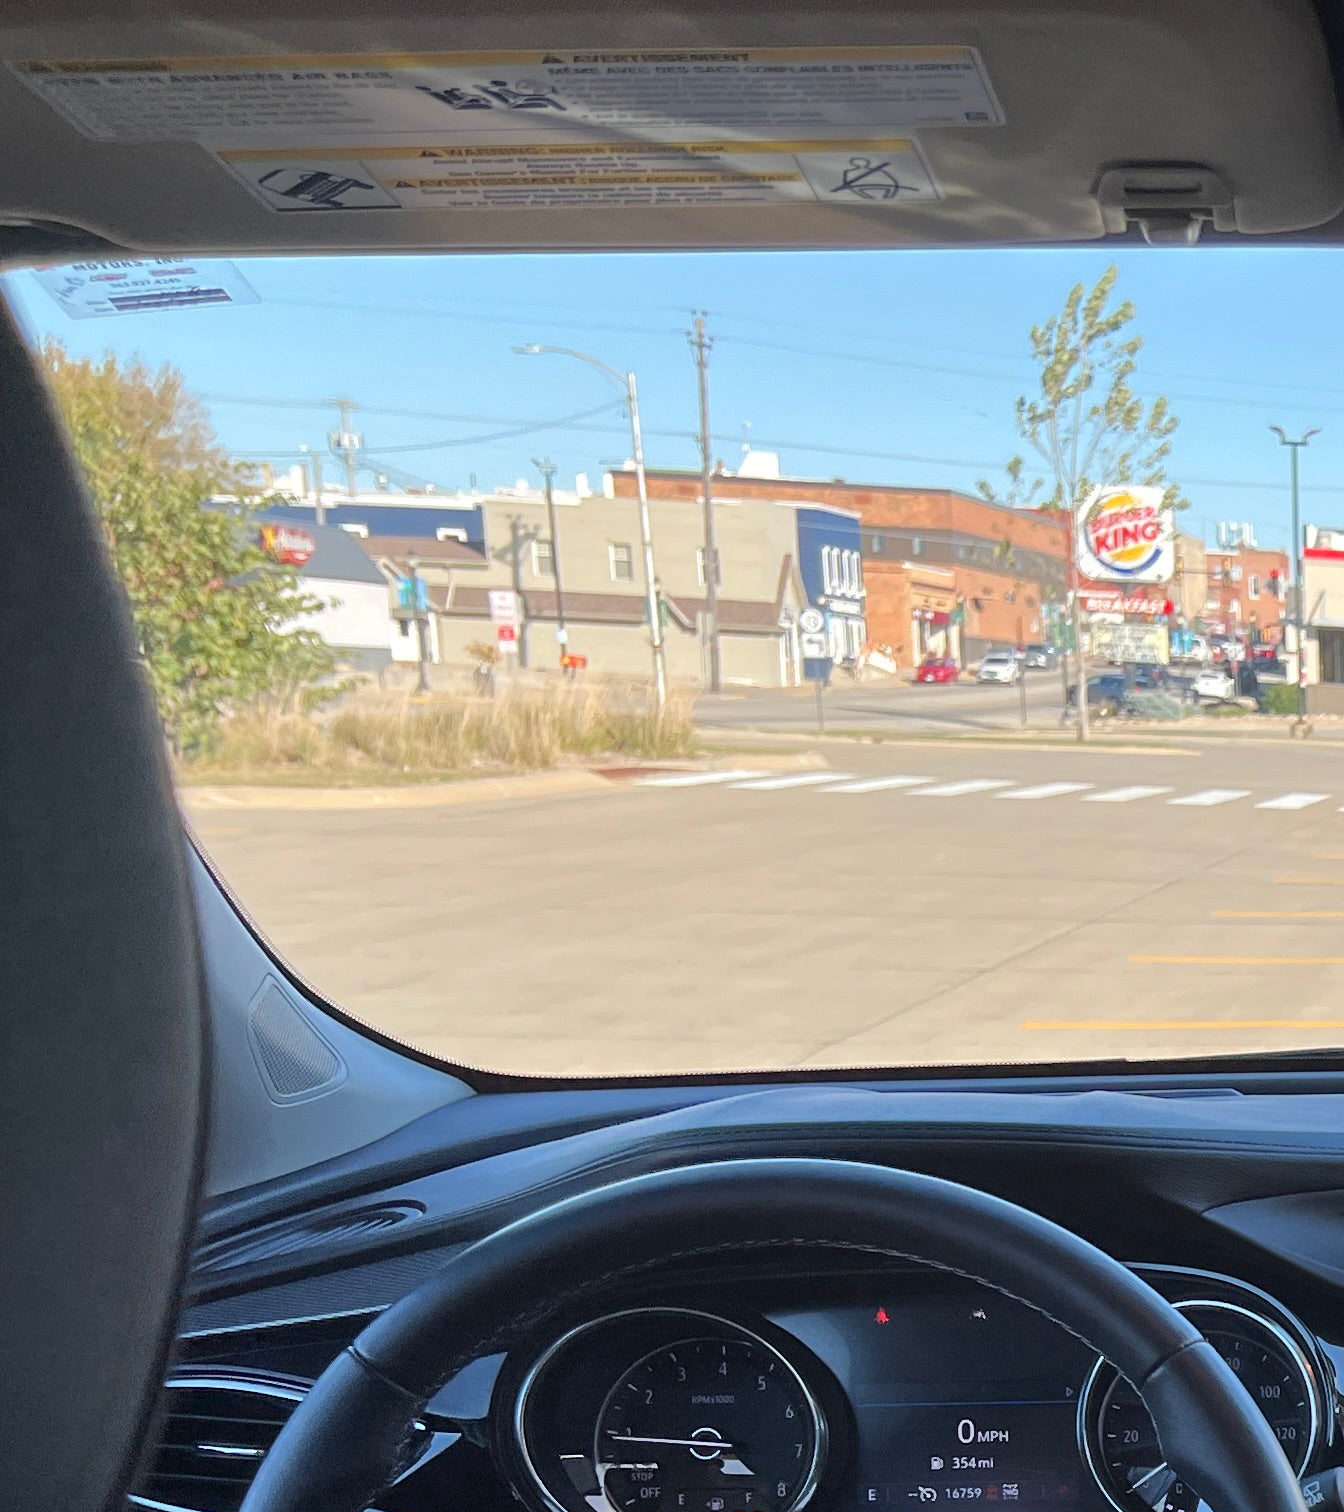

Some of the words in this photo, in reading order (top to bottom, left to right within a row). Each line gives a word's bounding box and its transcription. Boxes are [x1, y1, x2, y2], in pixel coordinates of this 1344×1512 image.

[1094, 521, 1162, 557] KING
[677, 1367, 686, 1382] 3
[719, 1361, 728, 1376] 4
[757, 1375, 767, 1391] 5
[645, 1389, 653, 1405] 2
[1259, 1384, 1281, 1399] 100
[785, 1405, 795, 1419] 6
[957, 1418, 975, 1444] 0
[977, 1430, 1009, 1443] MPH
[1123, 1430, 1139, 1444] 20
[1275, 1426, 1296, 1440] 120
[794, 1443, 803, 1458] 7
[952, 1457, 976, 1469] 354
[978, 1457, 994, 1469] mi
[640, 1487, 661, 1499] OFF
[777, 1482, 787, 1497] 8
[868, 1488, 877, 1501] E
[945, 1487, 982, 1499] 16759
[678, 1493, 685, 1506] E
[745, 1492, 753, 1504] F
